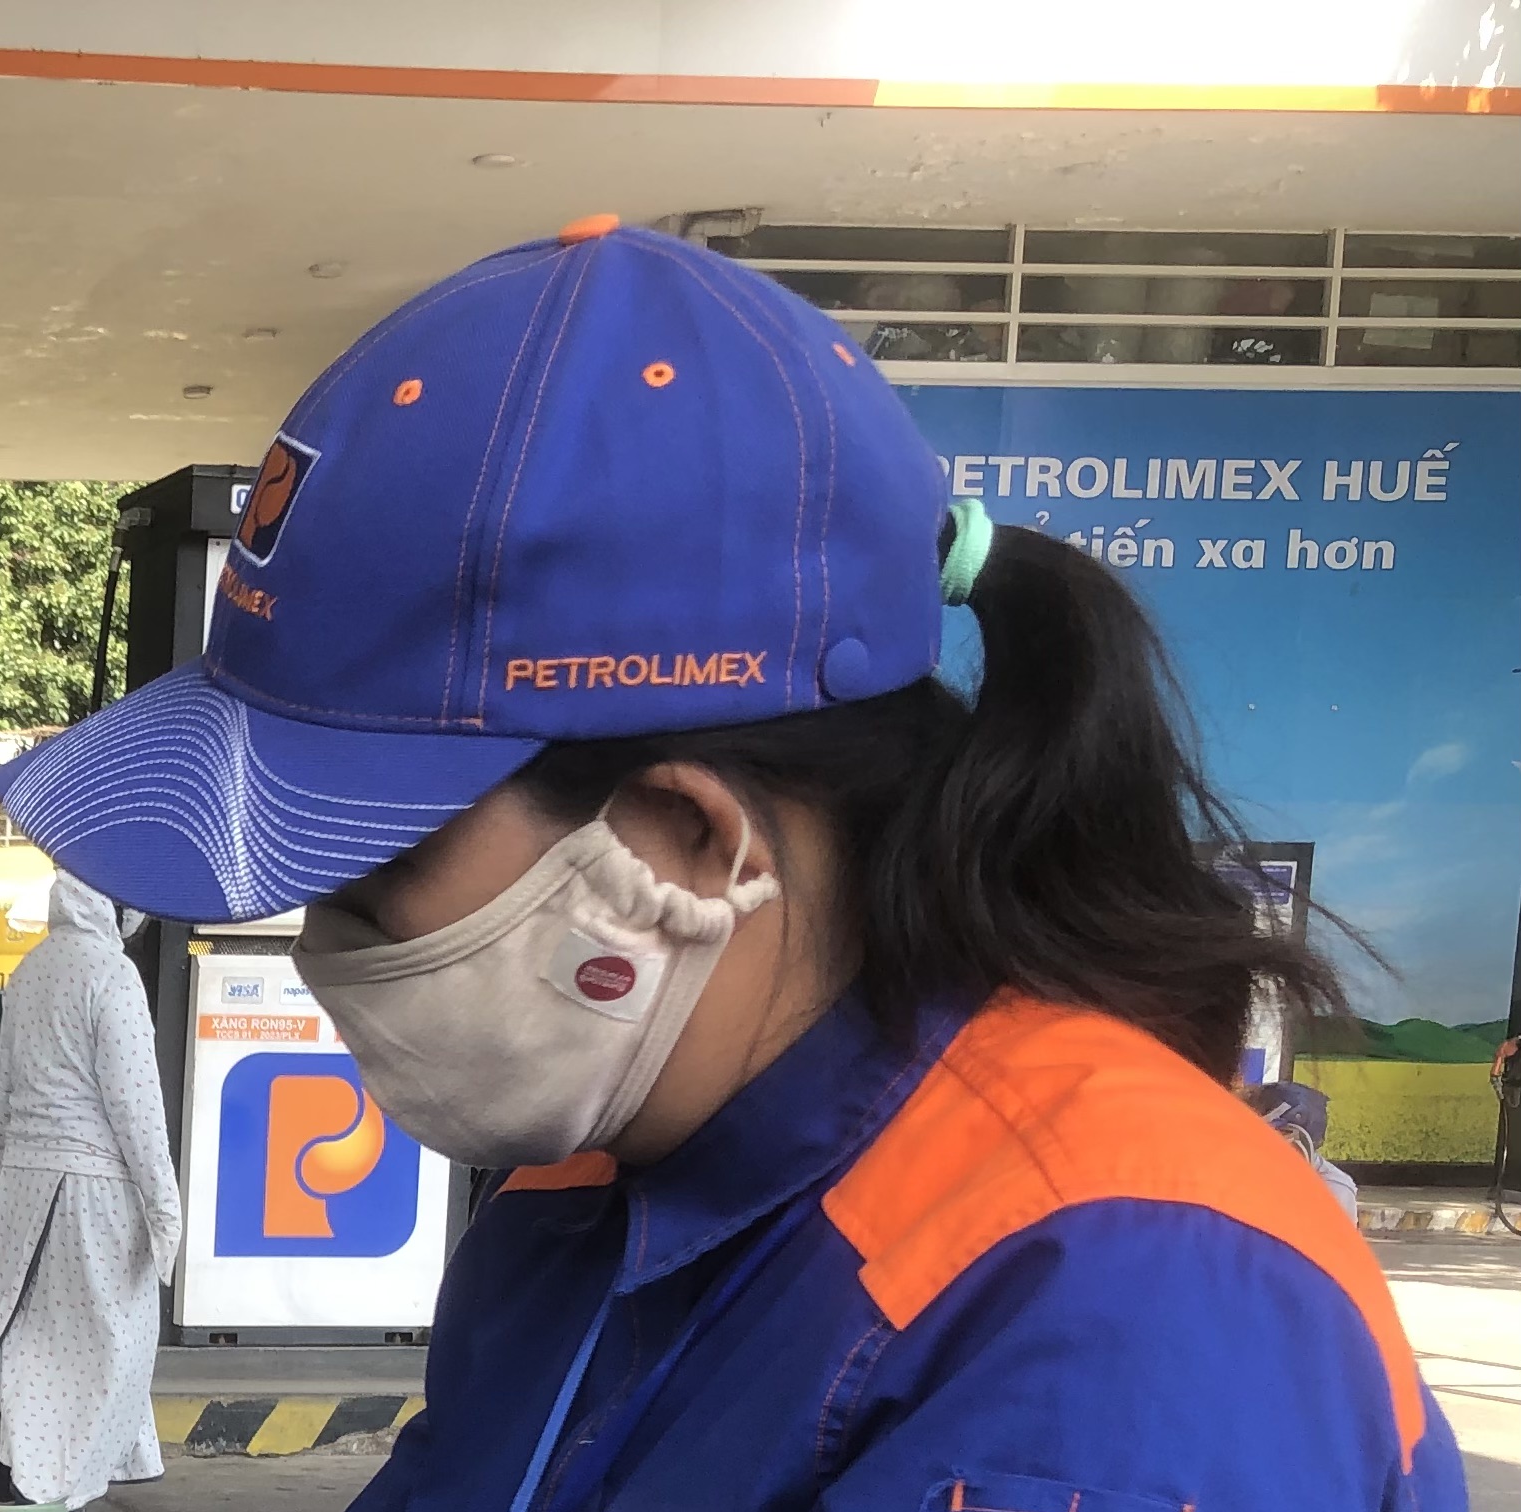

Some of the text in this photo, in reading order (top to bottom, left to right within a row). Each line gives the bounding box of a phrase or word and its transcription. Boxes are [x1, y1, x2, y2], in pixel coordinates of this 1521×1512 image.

[1323, 442, 1460, 502] HUẾ
[1195, 537, 1265, 569] xa
[1286, 528, 1395, 570] hơn
[505, 650, 768, 692] PETROLIMEX
[250, 1018, 307, 1031] RON95-V
